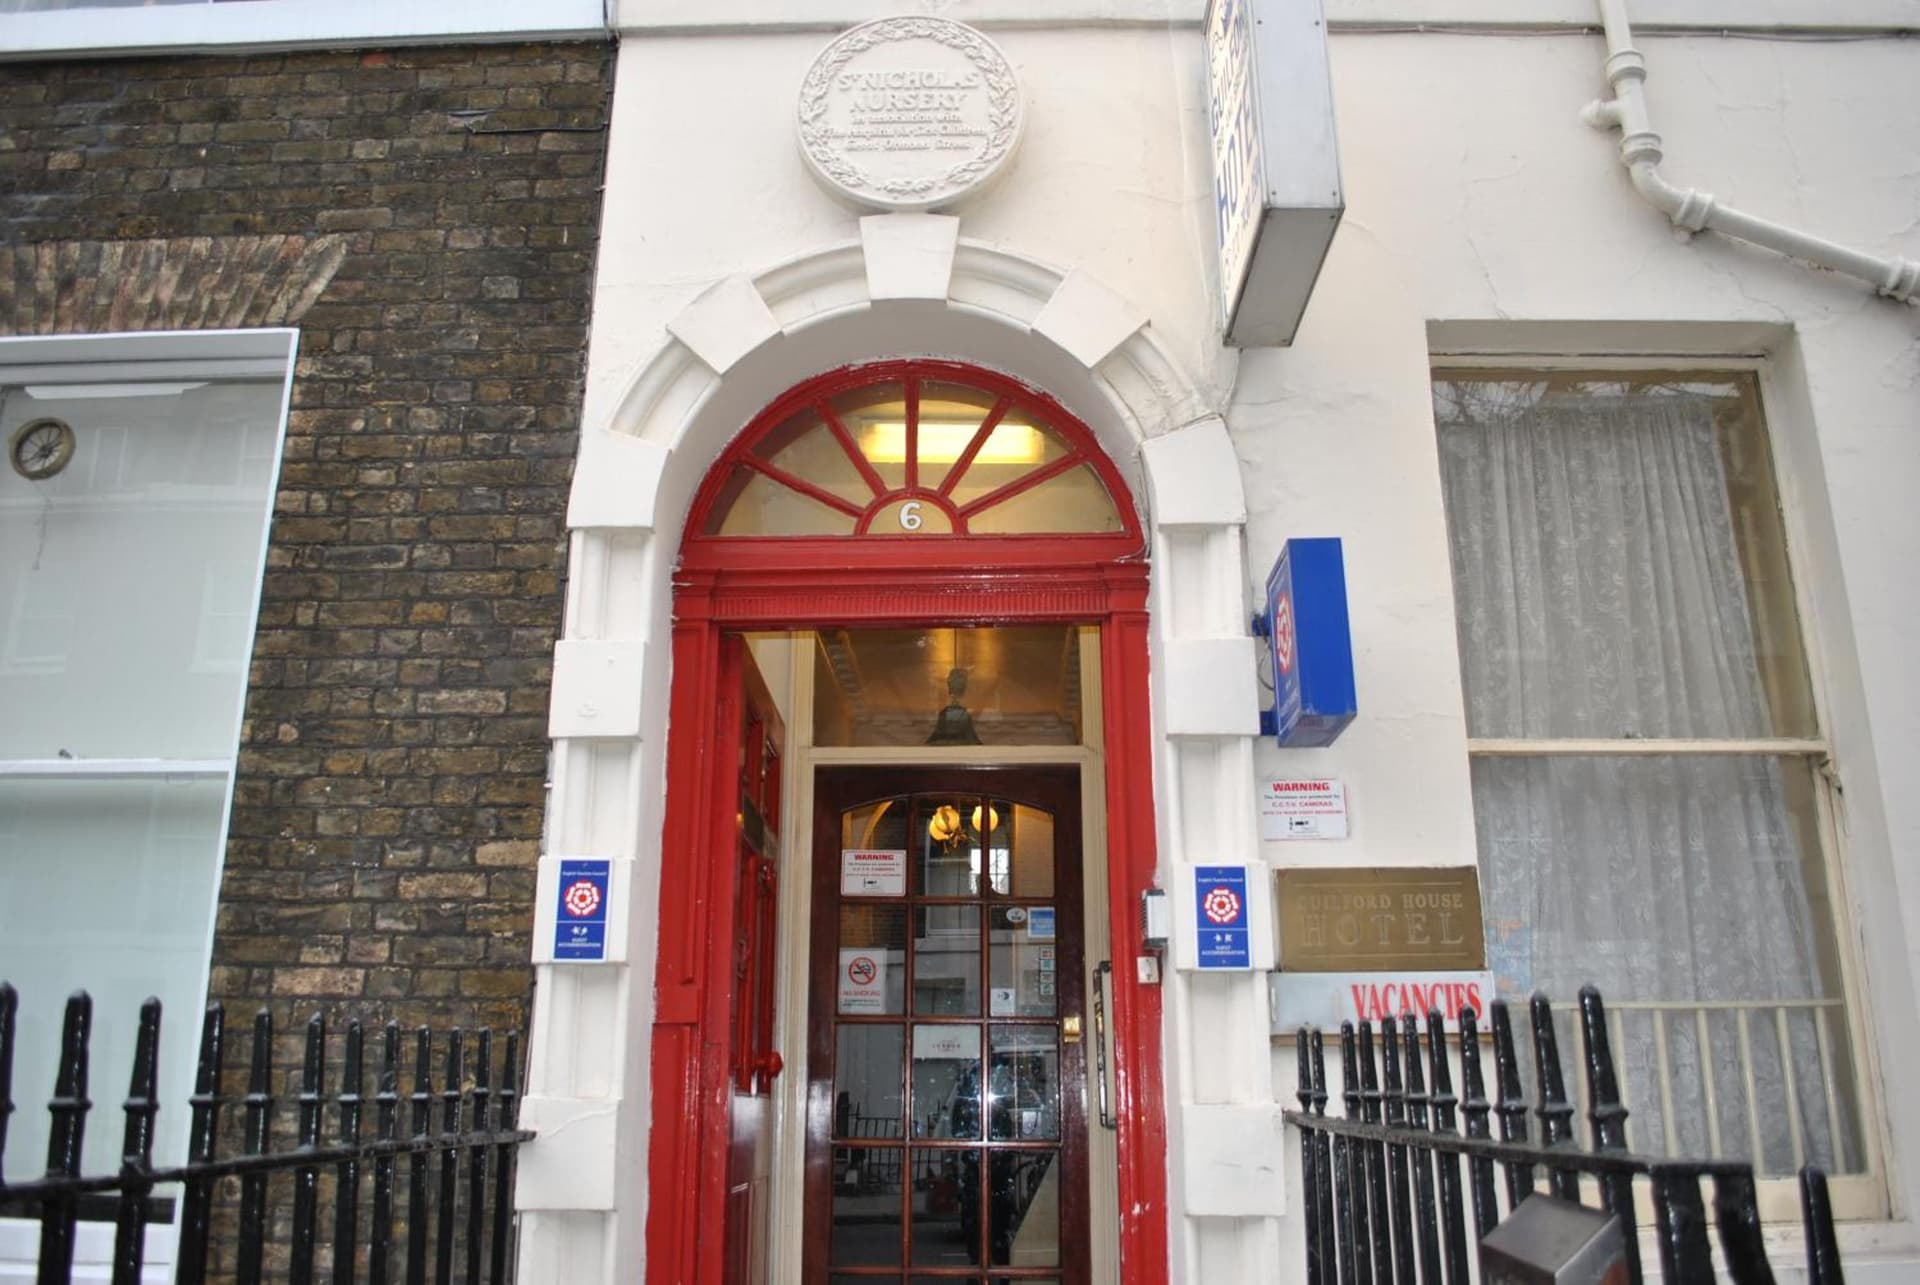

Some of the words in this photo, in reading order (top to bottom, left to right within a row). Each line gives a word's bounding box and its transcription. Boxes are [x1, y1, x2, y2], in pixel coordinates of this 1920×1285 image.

[849, 92, 967, 112] NURSERY
[899, 502, 922, 531] 6
[1272, 782, 1331, 792] WARNING
[1402, 893, 1463, 909] HOUSE
[1302, 912, 1464, 947] HOTEL
[1351, 981, 1482, 1022] VACANCIES
